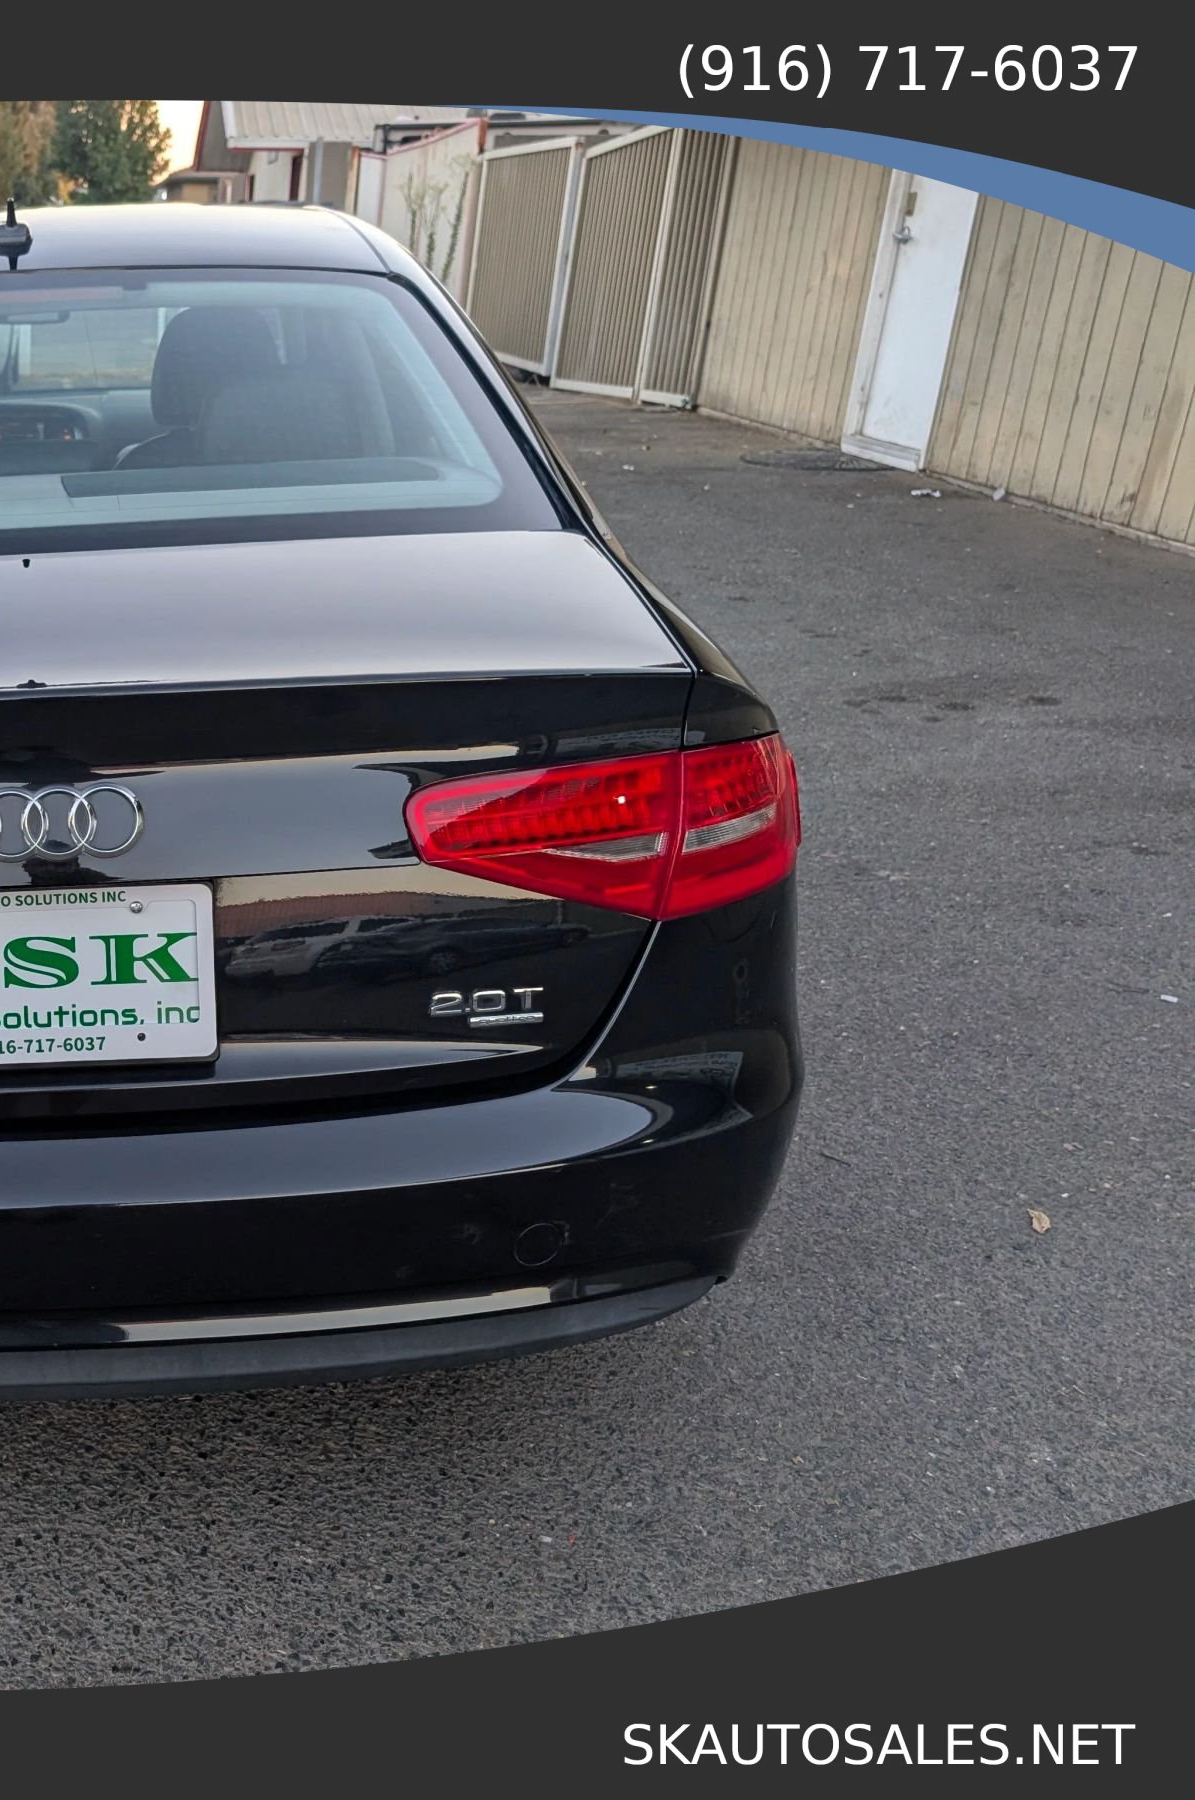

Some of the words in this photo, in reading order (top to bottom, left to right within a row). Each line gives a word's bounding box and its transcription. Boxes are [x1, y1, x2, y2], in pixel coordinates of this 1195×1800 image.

[15, 892, 97, 907] SOLUTIONS
[101, 890, 127, 903] INC
[3, 932, 199, 989] SK
[157, 1001, 201, 1024] inc
